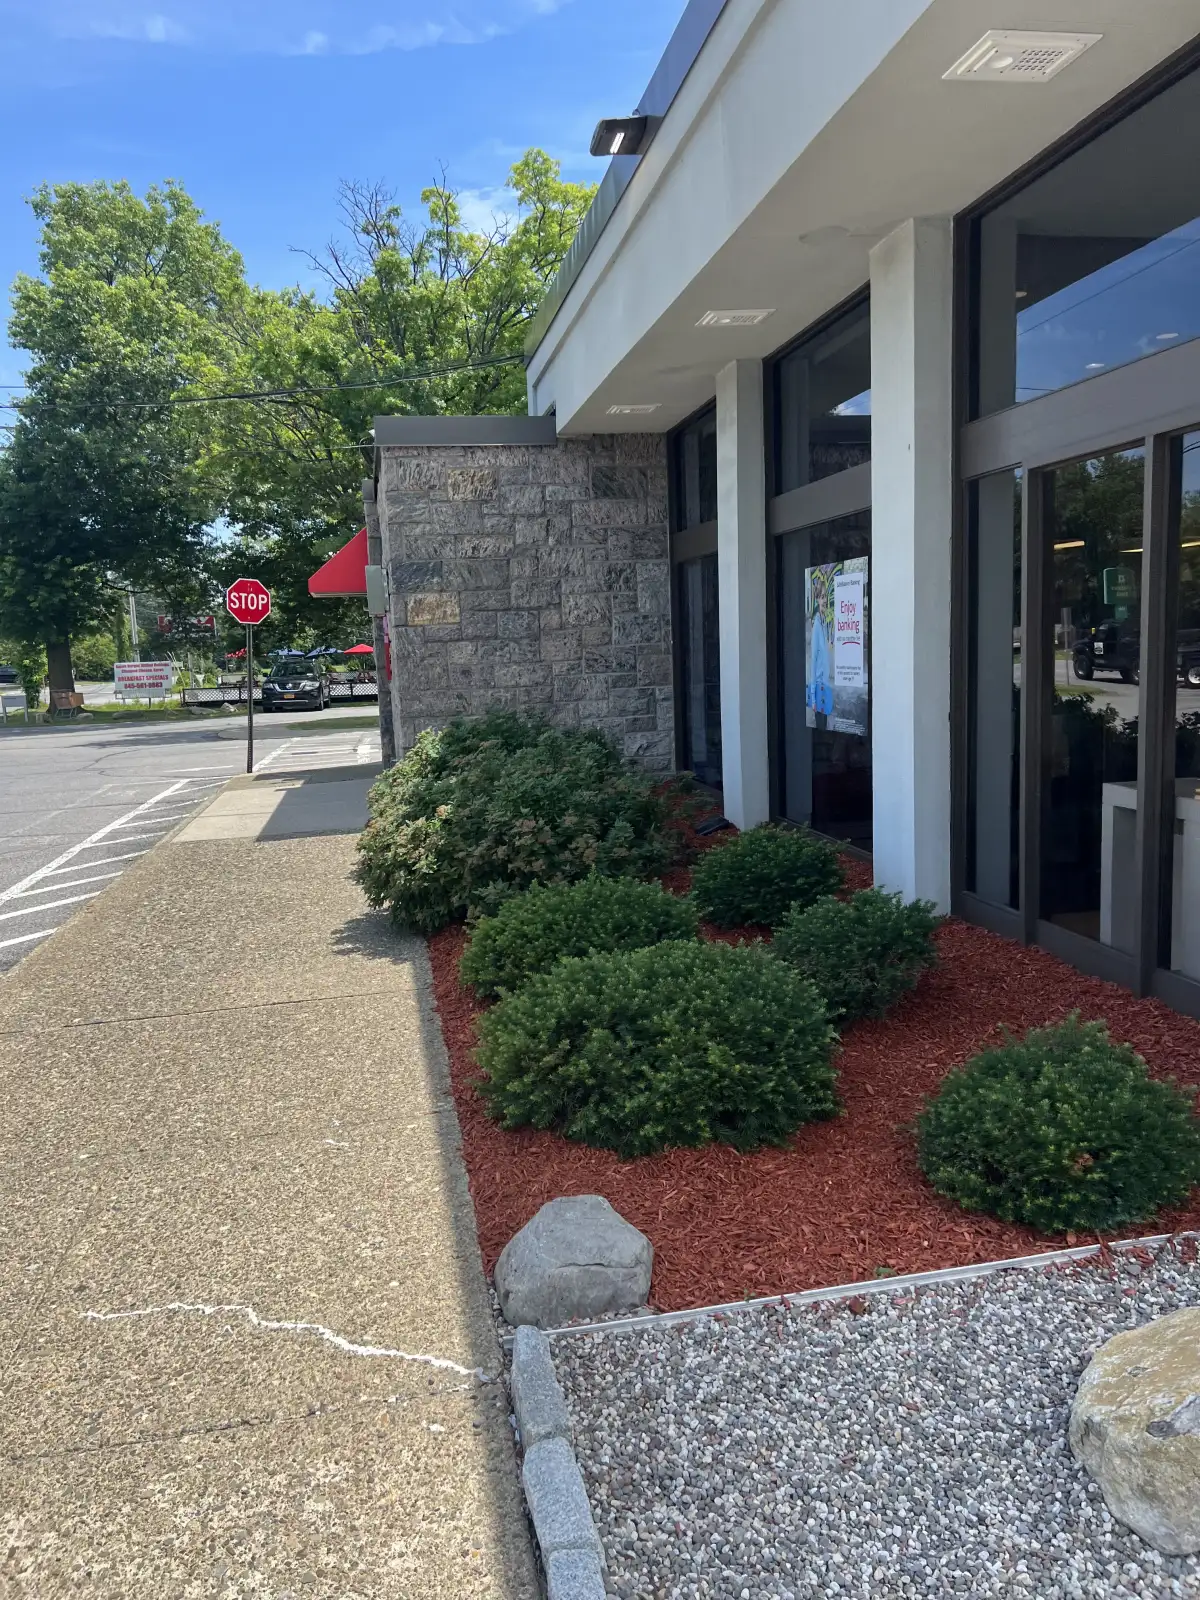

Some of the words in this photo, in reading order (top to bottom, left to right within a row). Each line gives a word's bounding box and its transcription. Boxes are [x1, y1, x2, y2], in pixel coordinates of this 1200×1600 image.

[230, 592, 268, 611] STOP
[840, 600, 857, 616] Enjoy
[837, 617, 860, 634] banking
